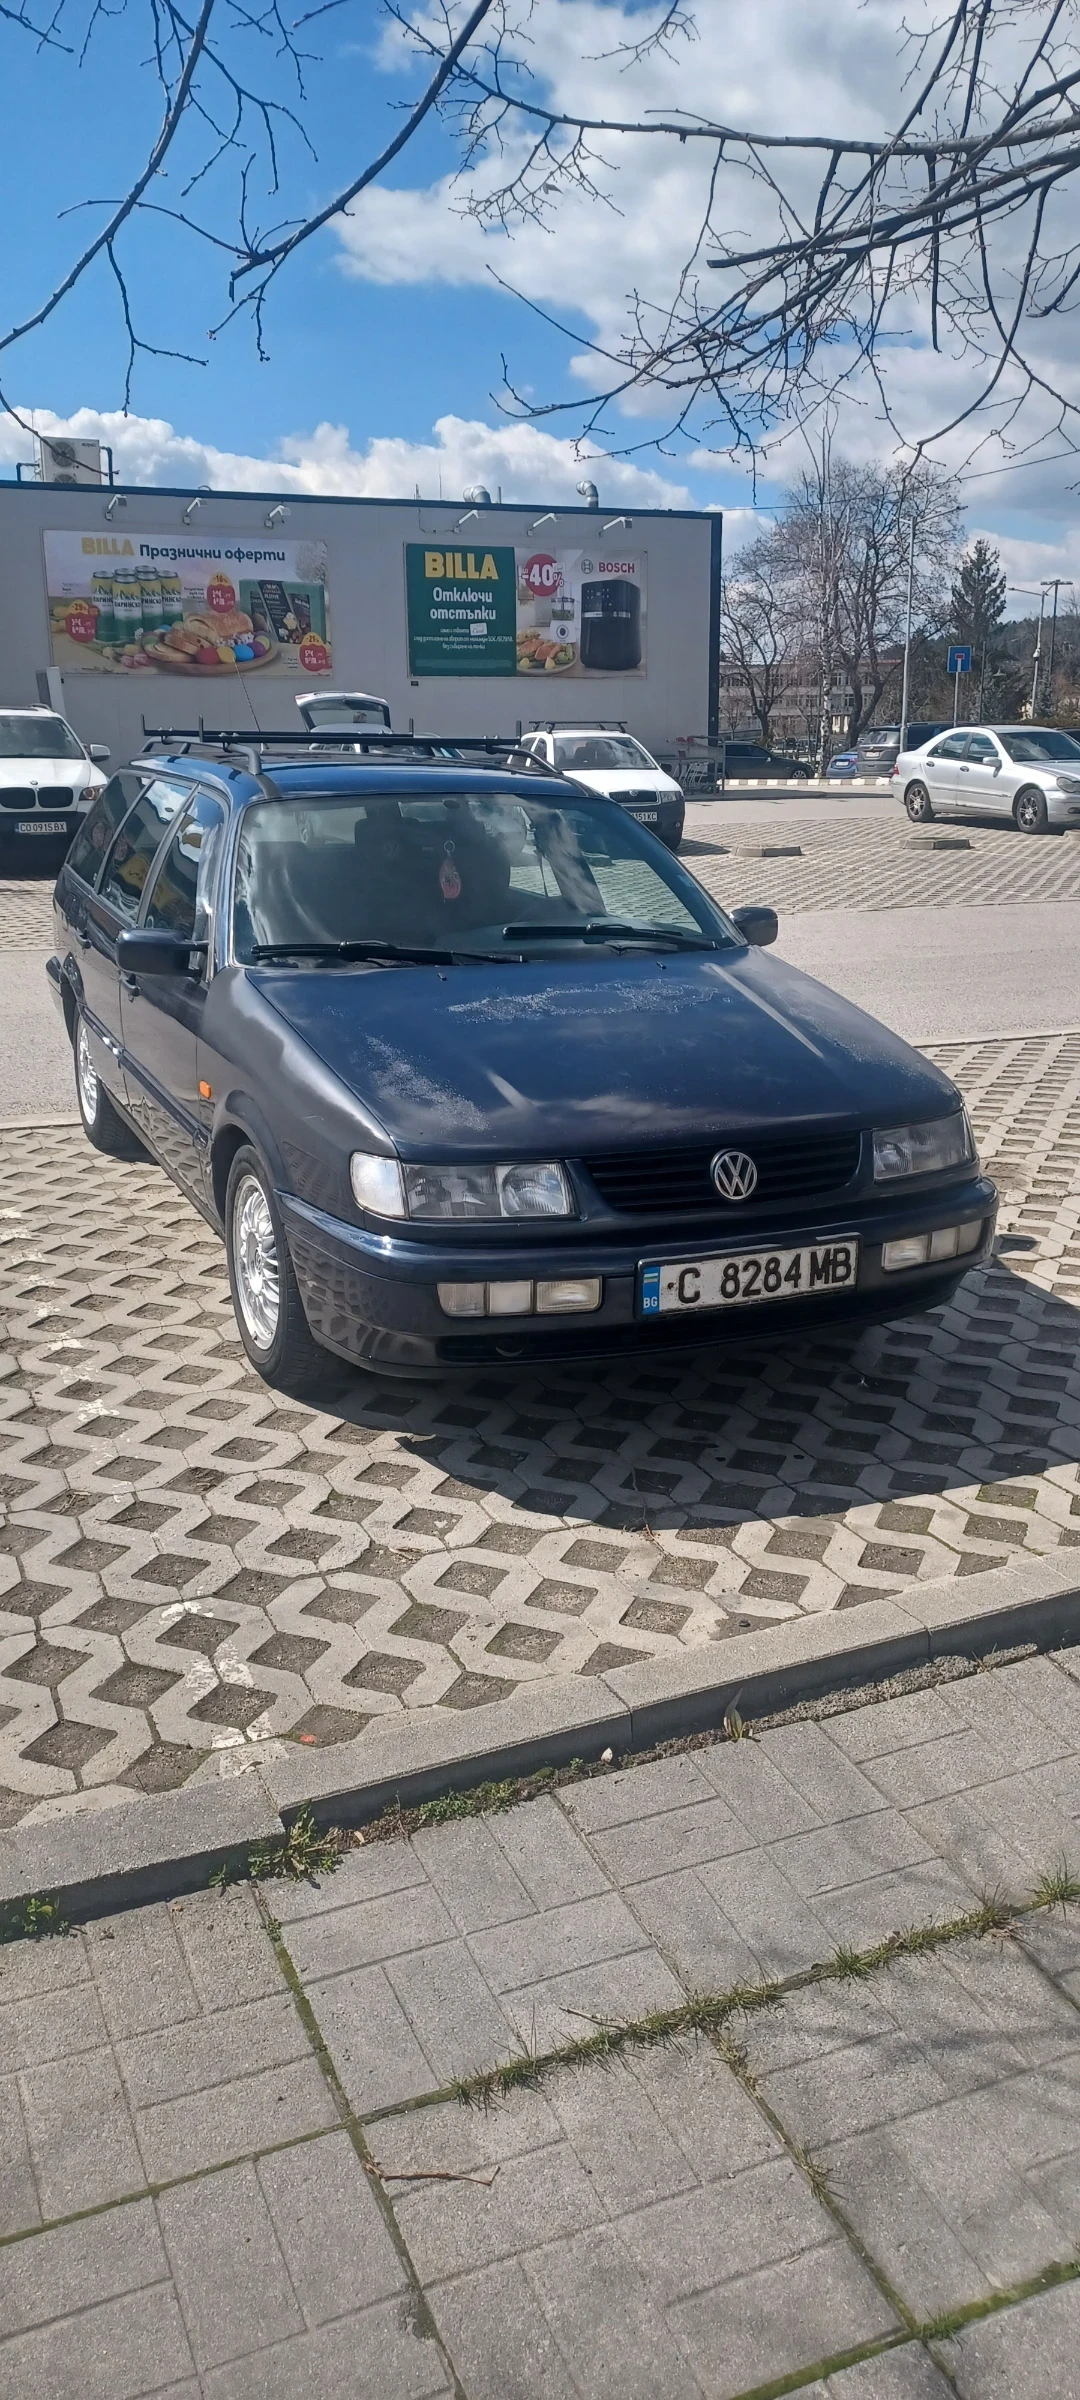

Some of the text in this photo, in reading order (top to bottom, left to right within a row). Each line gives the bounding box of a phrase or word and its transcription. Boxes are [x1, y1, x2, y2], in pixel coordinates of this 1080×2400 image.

[81, 537, 135, 556] BILLA
[139, 544, 285, 563] Празнични оферти
[424, 551, 499, 580] BILLA
[598, 562, 635, 573] BOSCH
[432, 586, 493, 602] Отключи
[430, 606, 497, 620] отстъпки
[20, 823, 31, 832] CO
[33, 823, 53, 832] 0915
[678, 1247, 852, 1304] C 8284 MB
[643, 1296, 658, 1309] BG
